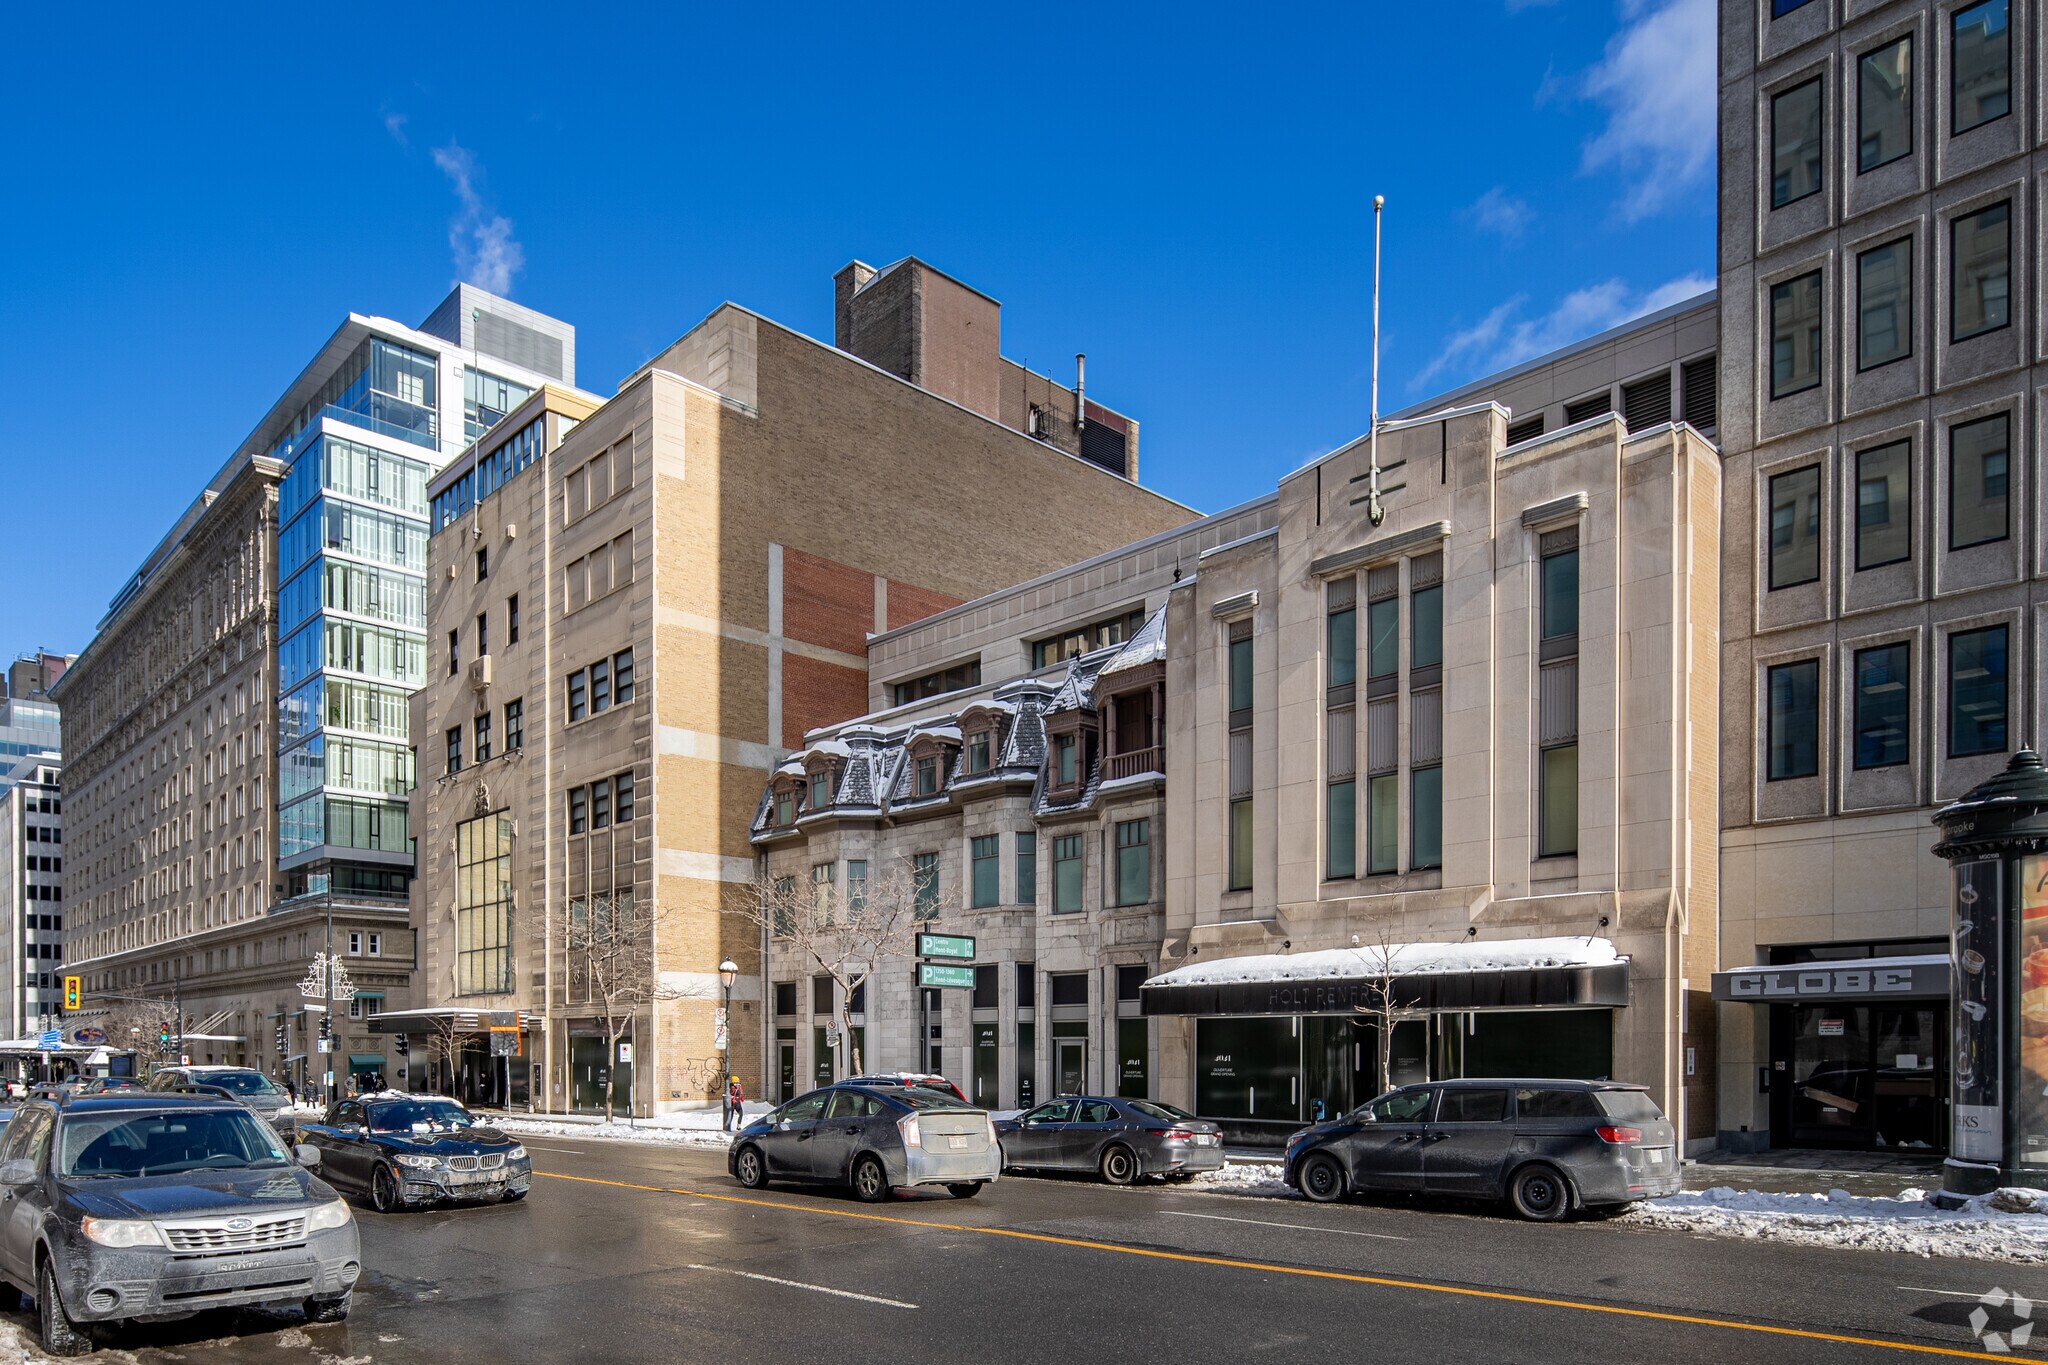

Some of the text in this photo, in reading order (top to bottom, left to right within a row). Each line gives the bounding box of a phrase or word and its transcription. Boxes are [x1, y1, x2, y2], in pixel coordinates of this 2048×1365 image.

[923, 937, 933, 953] P
[923, 967, 933, 983] P
[1730, 969, 1912, 996] GLOBE
[1269, 985, 1396, 1005] HOLT RENFRE
